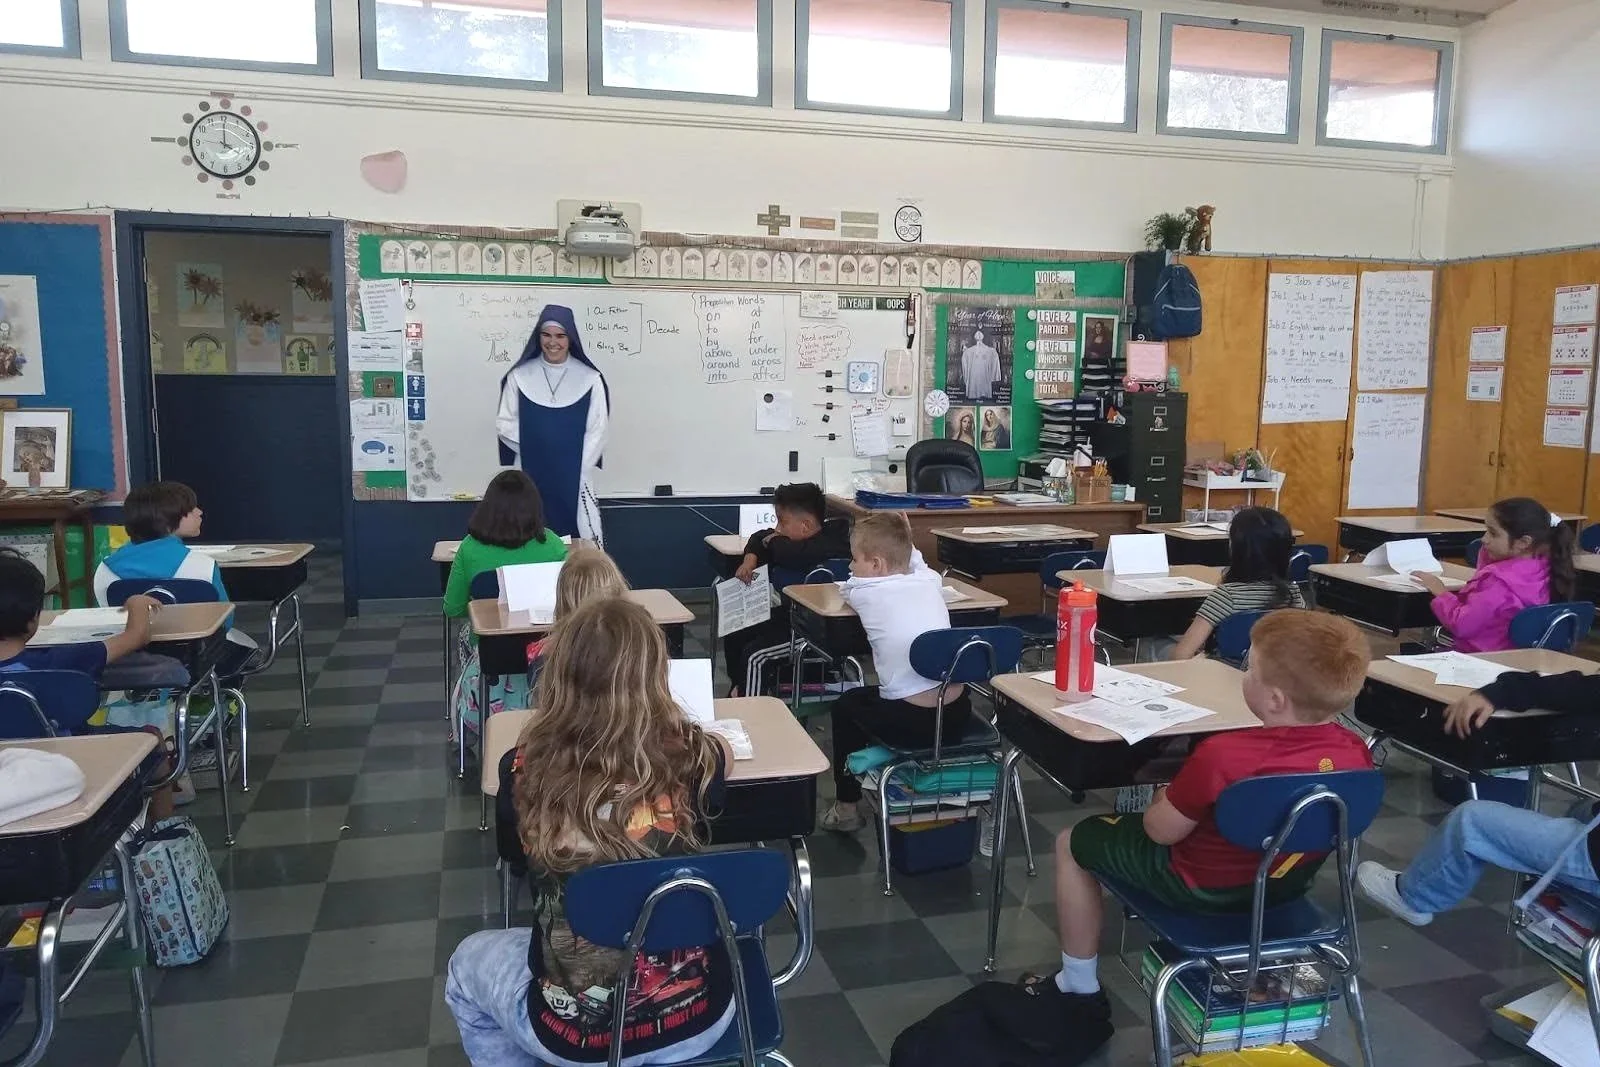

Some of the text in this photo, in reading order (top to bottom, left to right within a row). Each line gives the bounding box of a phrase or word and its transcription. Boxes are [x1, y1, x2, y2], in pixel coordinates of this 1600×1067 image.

[1037, 271, 1061, 283] VOICE
[738, 293, 765, 306] Words
[849, 298, 870, 309] YEAH!
[886, 299, 905, 309] OOPS
[706, 312, 721, 322] on
[751, 306, 763, 318] at
[955, 309, 976, 321] Year
[1039, 311, 1070, 322] LEVEL 2
[585, 323, 594, 331] 10
[646, 319, 680, 335] Decade
[706, 323, 718, 334] to
[751, 321, 760, 330] in
[1039, 324, 1069, 335] PARTNER
[706, 336, 719, 350] by
[748, 331, 764, 345] for
[705, 348, 733, 358] above
[749, 343, 778, 356] under
[1038, 342, 1069, 353] LEVEL 1
[707, 358, 740, 369] around
[752, 358, 782, 367] across
[1038, 353, 1067, 364] WHISPER
[708, 370, 728, 382] into
[752, 366, 780, 381] after
[1037, 371, 1068, 382] LEVEL 0
[1268, 375, 1279, 384] Job
[1290, 375, 1311, 384] Needs
[1039, 383, 1058, 394] TOTAL
[636, 1022, 654, 1039] FIRE
